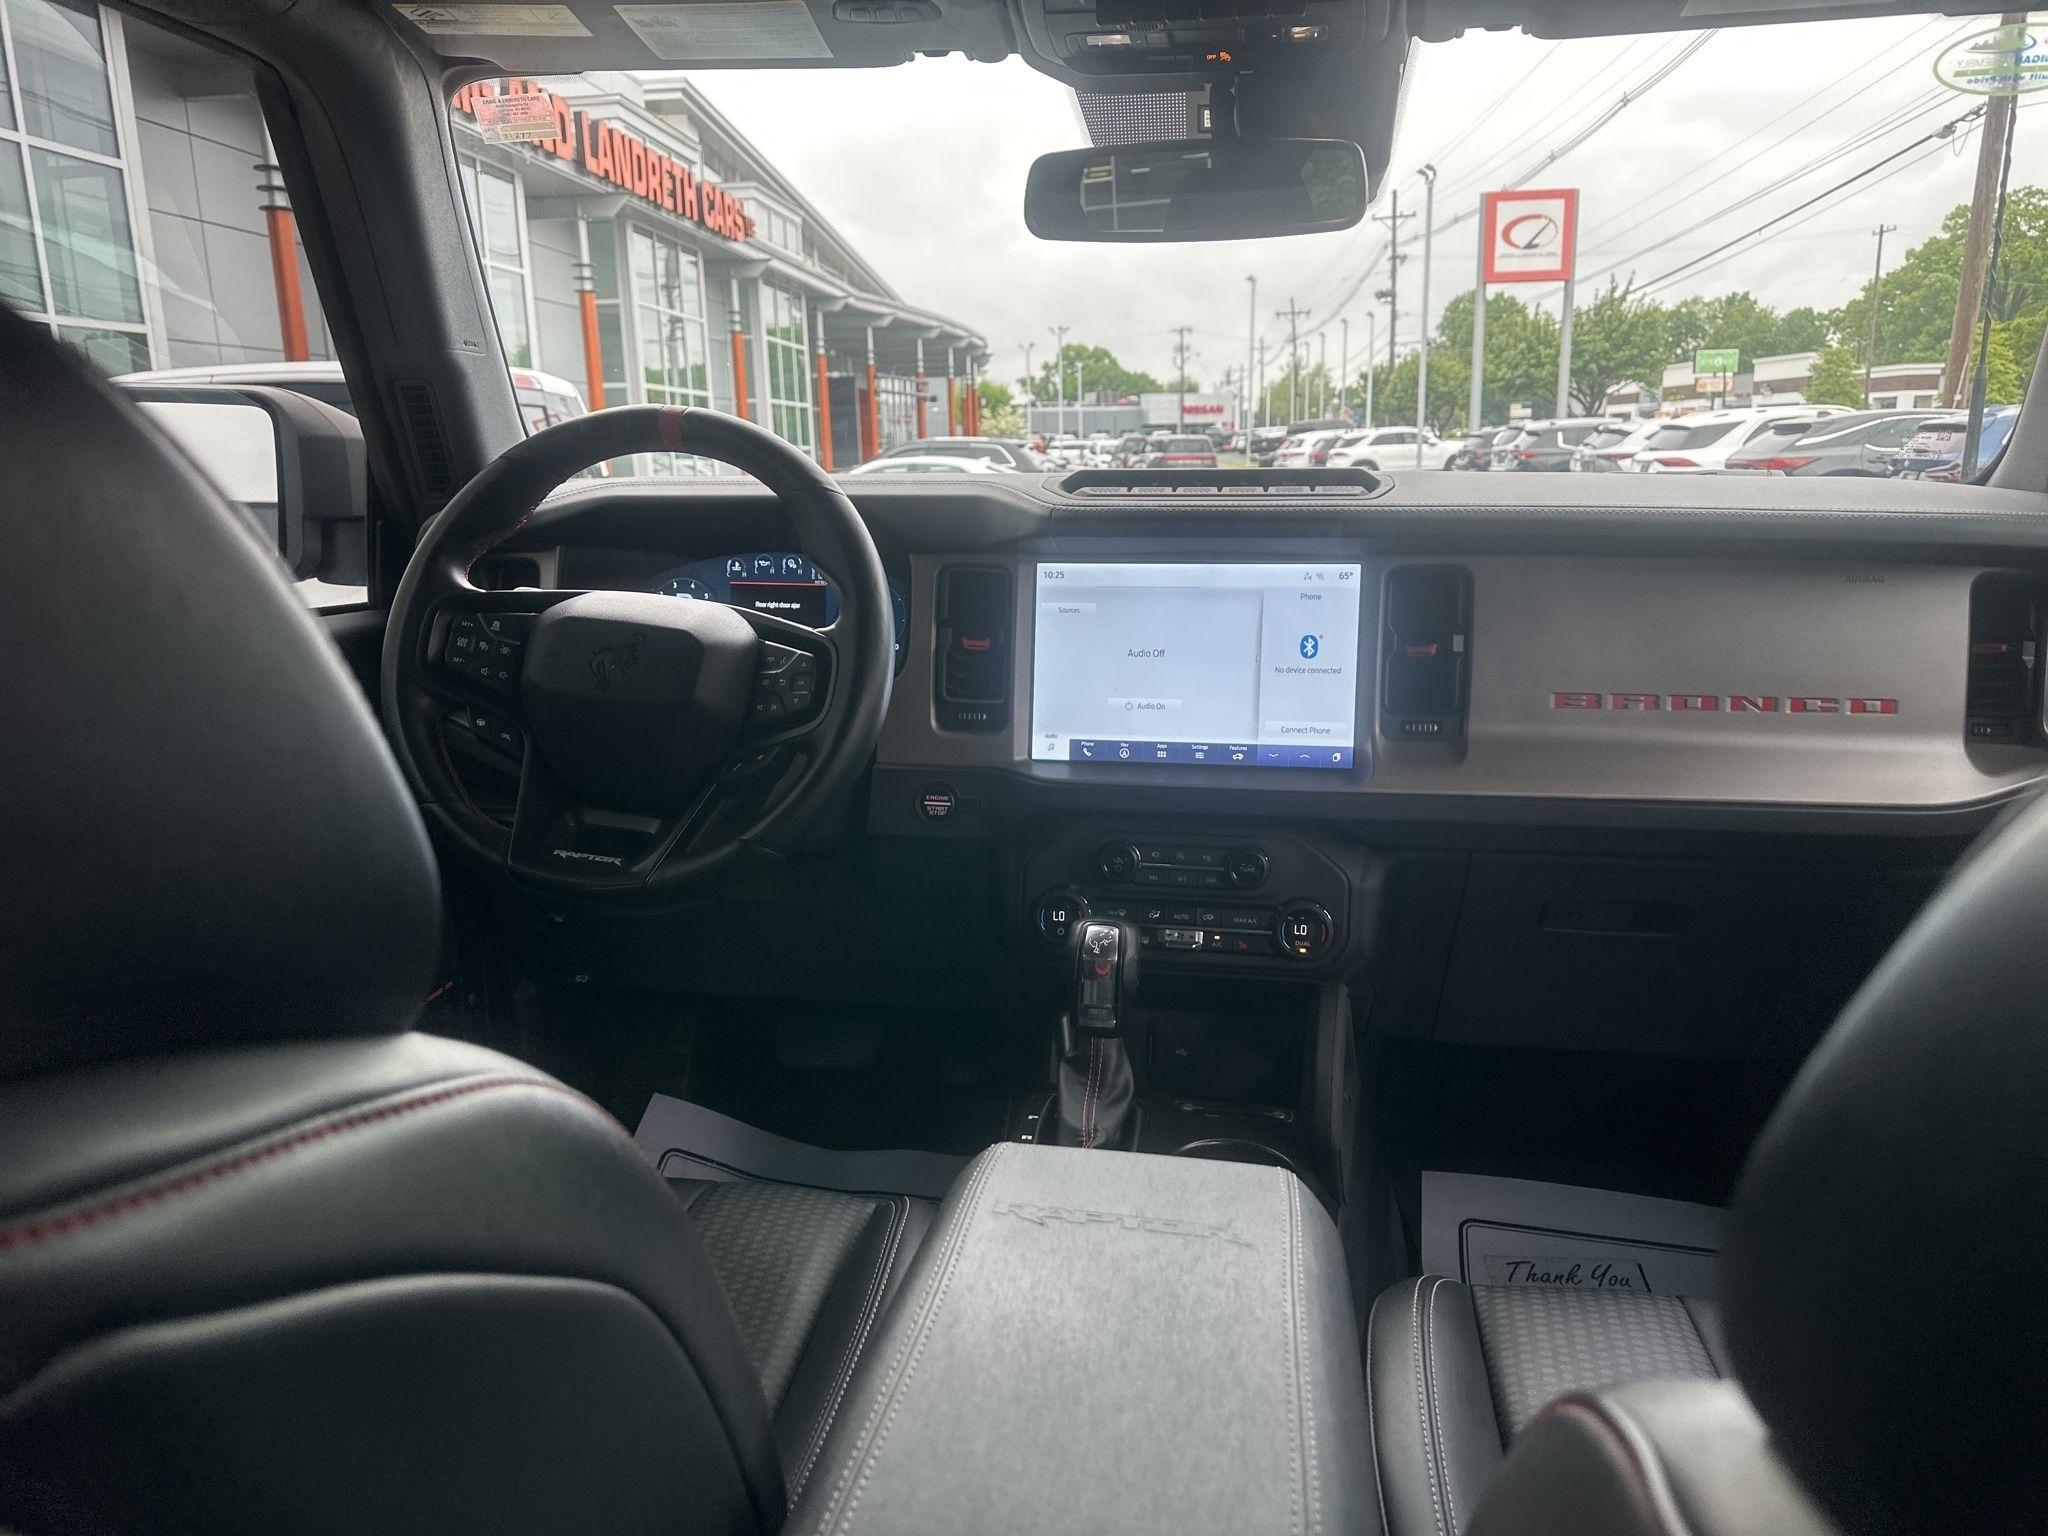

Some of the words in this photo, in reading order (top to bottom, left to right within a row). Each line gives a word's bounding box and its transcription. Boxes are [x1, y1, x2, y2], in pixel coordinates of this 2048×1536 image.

[580, 111, 698, 221] LANDRETH
[702, 180, 746, 242] CARS
[1043, 571, 1065, 579] 10:25
[1300, 592, 1322, 600] Phone
[767, 601, 779, 609] right
[1058, 606, 1081, 614] Sources
[1127, 648, 1151, 658] Audio
[1152, 648, 1166, 658] Off
[1274, 666, 1284, 674] No
[1285, 666, 1306, 674] device
[1307, 666, 1342, 675] connected
[1137, 702, 1155, 710] Audio
[1156, 702, 1166, 710] On
[1551, 692, 1898, 715] BRONCO
[1281, 726, 1308, 734] Connect
[1309, 726, 1331, 735] Phone
[553, 850, 622, 867] RAPTOR
[1052, 910, 1066, 922] LO
[1294, 924, 1307, 935] LO
[1505, 1260, 1583, 1285] Thank
[1590, 1263, 1632, 1288] You
